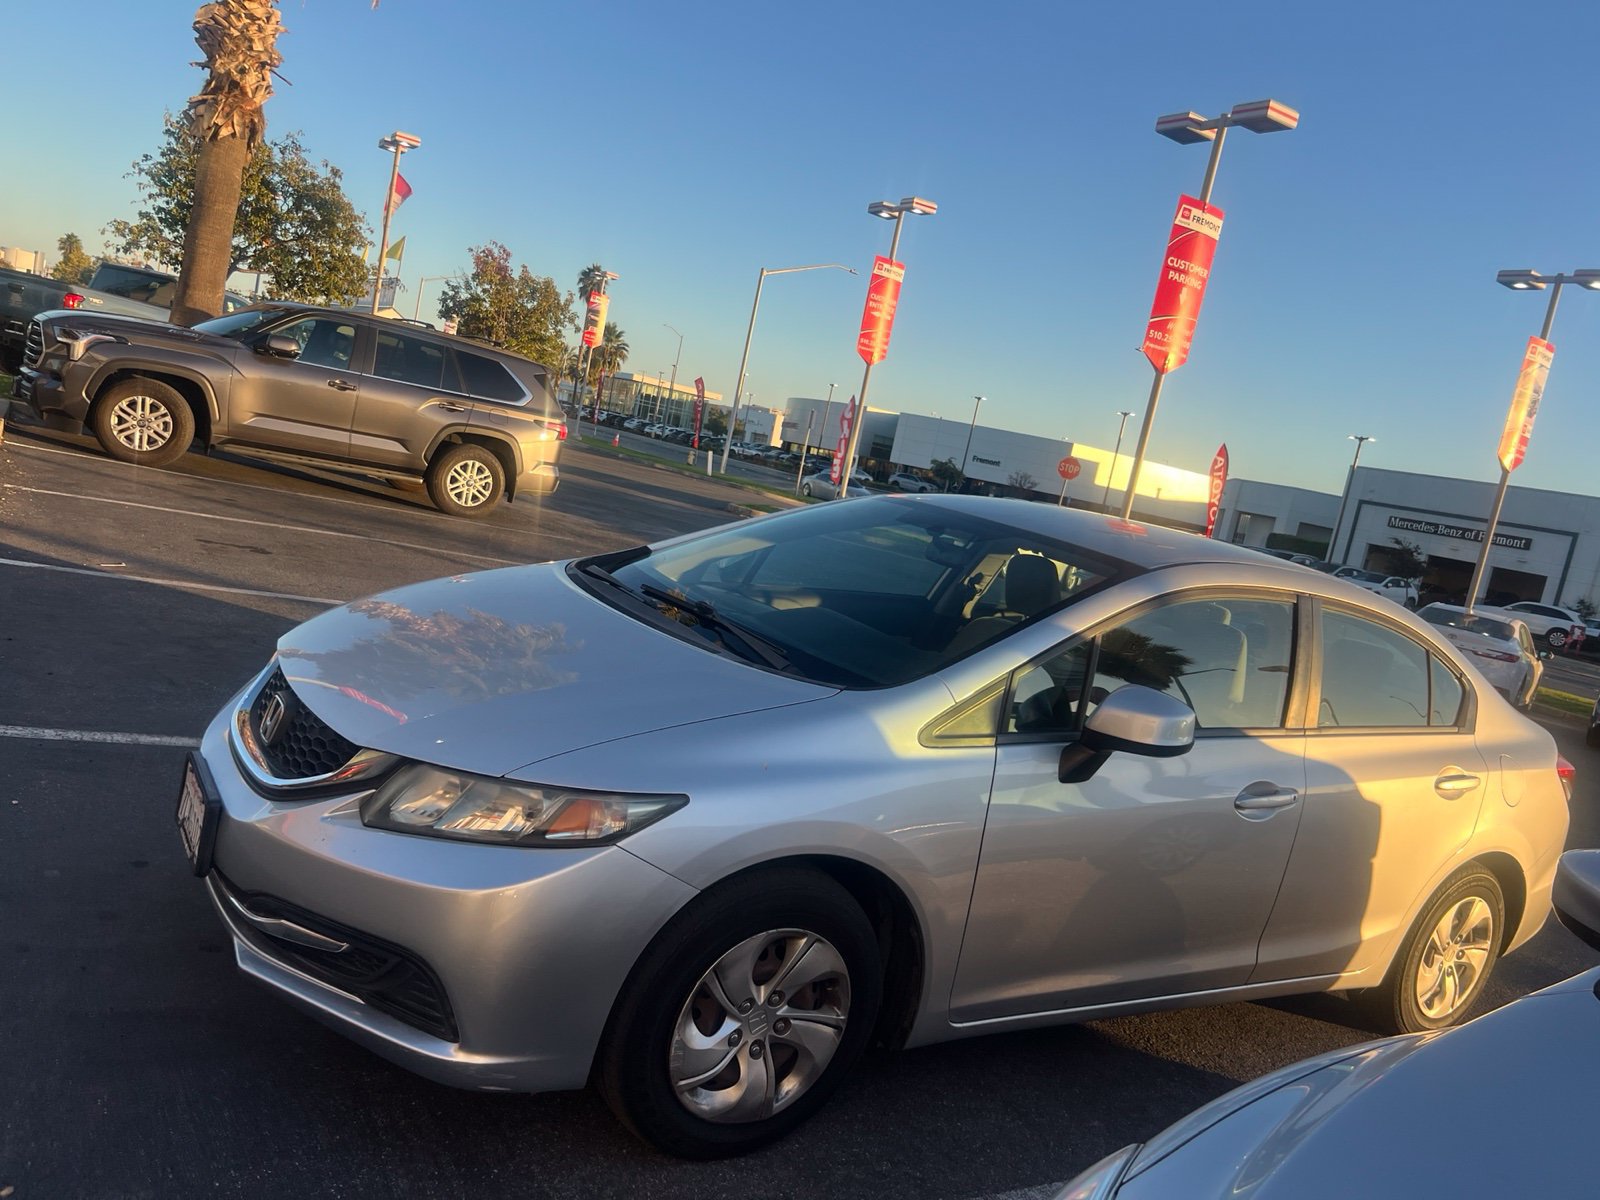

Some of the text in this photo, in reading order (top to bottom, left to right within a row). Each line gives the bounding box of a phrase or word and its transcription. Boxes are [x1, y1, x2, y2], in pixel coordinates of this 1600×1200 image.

[1192, 215, 1220, 232] FREMONT
[1167, 256, 1208, 279] CUSTOMER
[1168, 270, 1202, 290] PARKING
[972, 455, 1001, 467] Fremont
[1059, 462, 1080, 474] STOP
[1389, 517, 1527, 549] Mercedes-Benz of Femont
